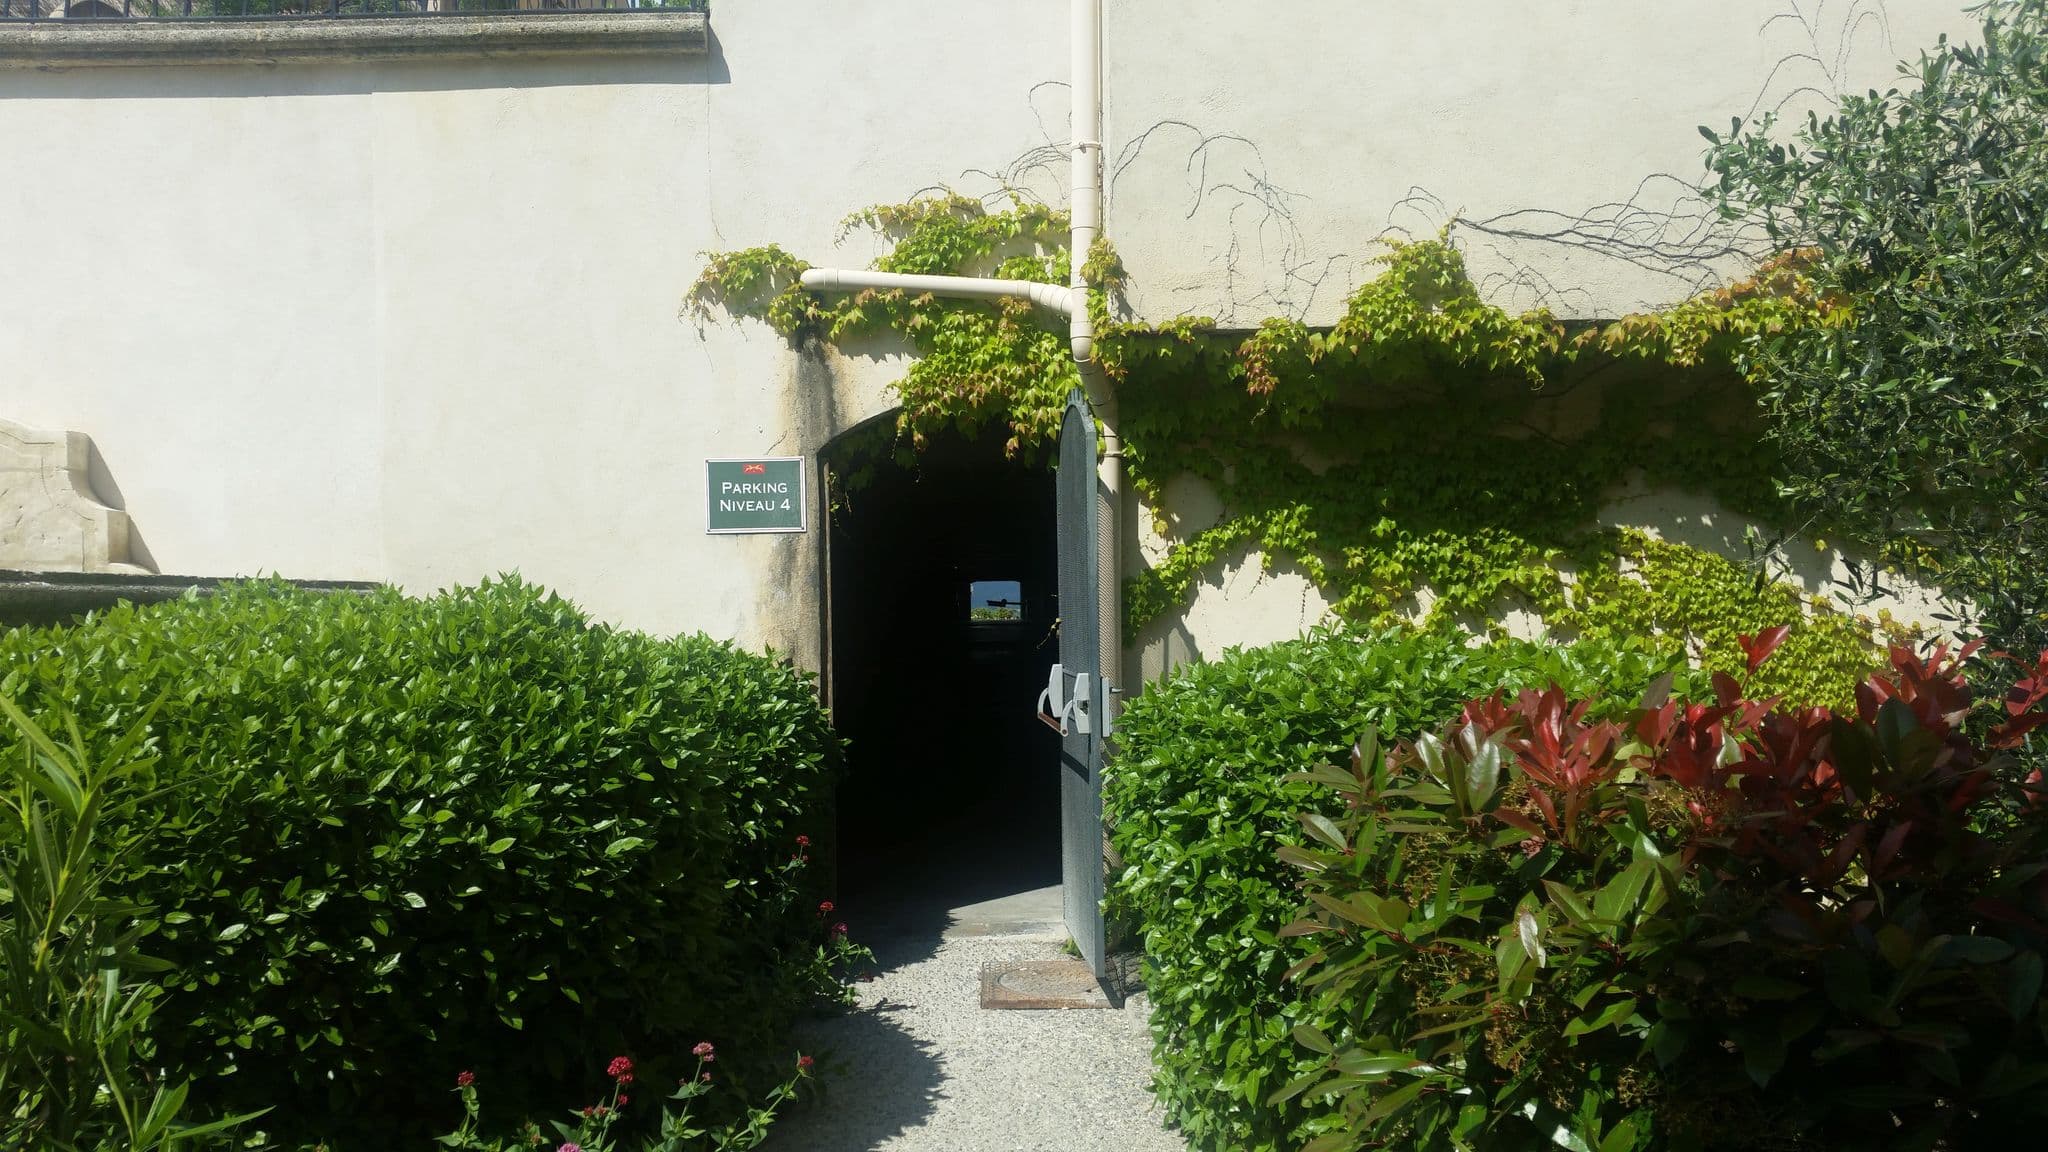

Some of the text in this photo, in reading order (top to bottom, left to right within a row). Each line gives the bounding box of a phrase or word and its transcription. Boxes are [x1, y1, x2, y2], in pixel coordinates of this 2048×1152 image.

[722, 481, 788, 494] PARKING
[720, 498, 791, 512] NIVEAU 4
